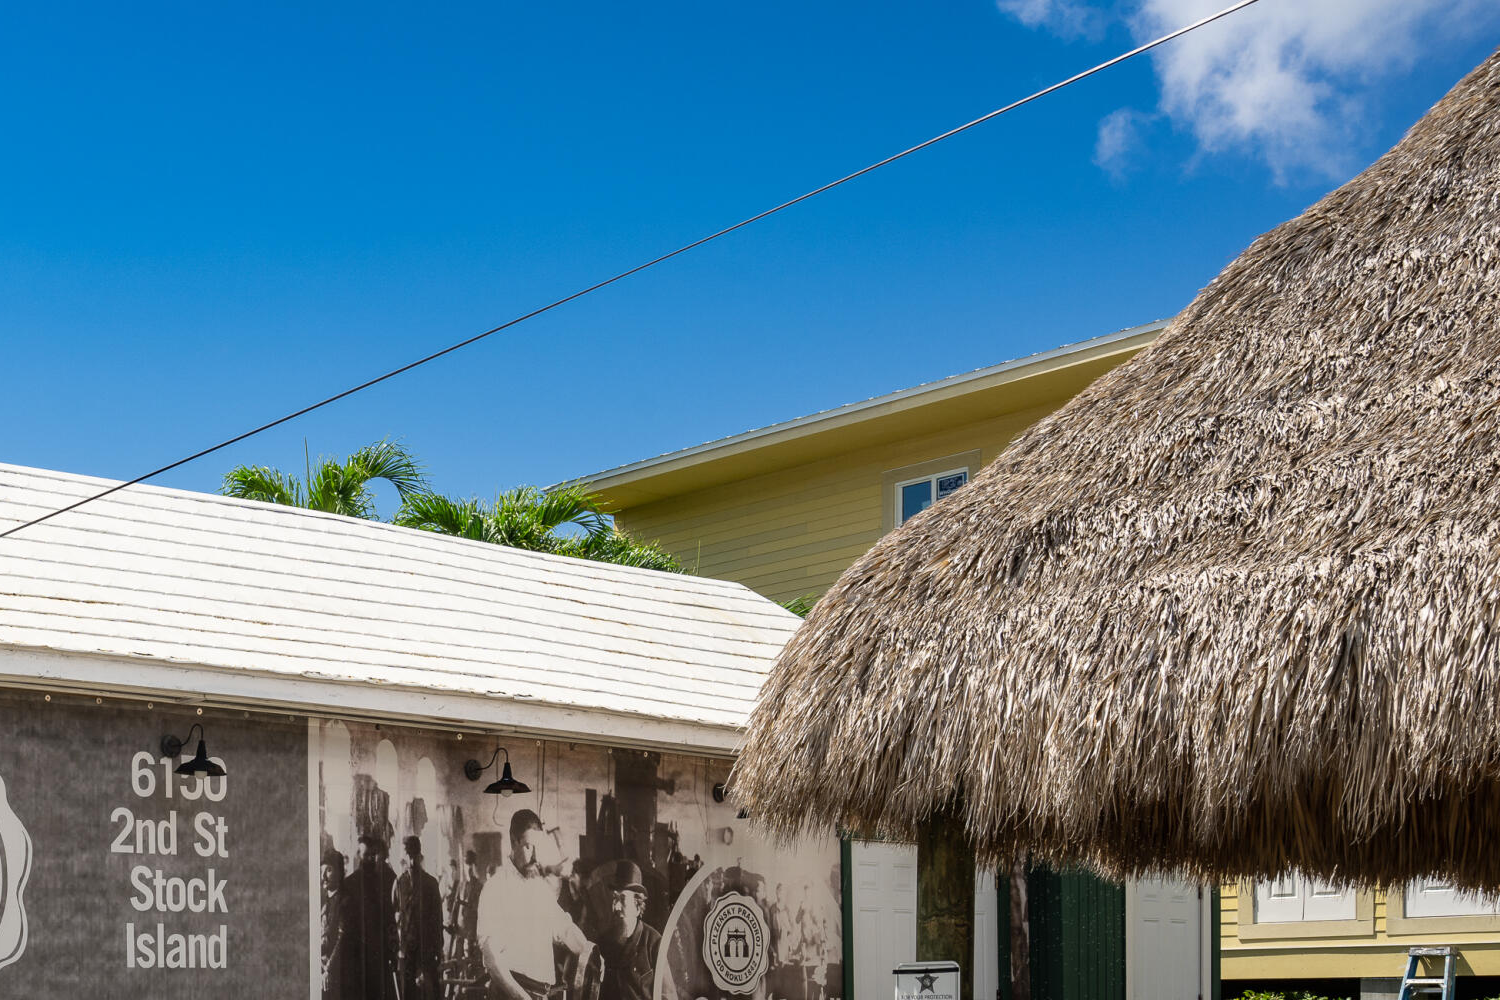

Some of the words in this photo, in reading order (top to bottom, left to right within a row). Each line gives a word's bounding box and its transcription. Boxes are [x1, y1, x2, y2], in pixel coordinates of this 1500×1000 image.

[110, 806, 178, 856] 2nd
[193, 811, 229, 858] St
[129, 865, 229, 913] Stock
[126, 922, 228, 969] Island
